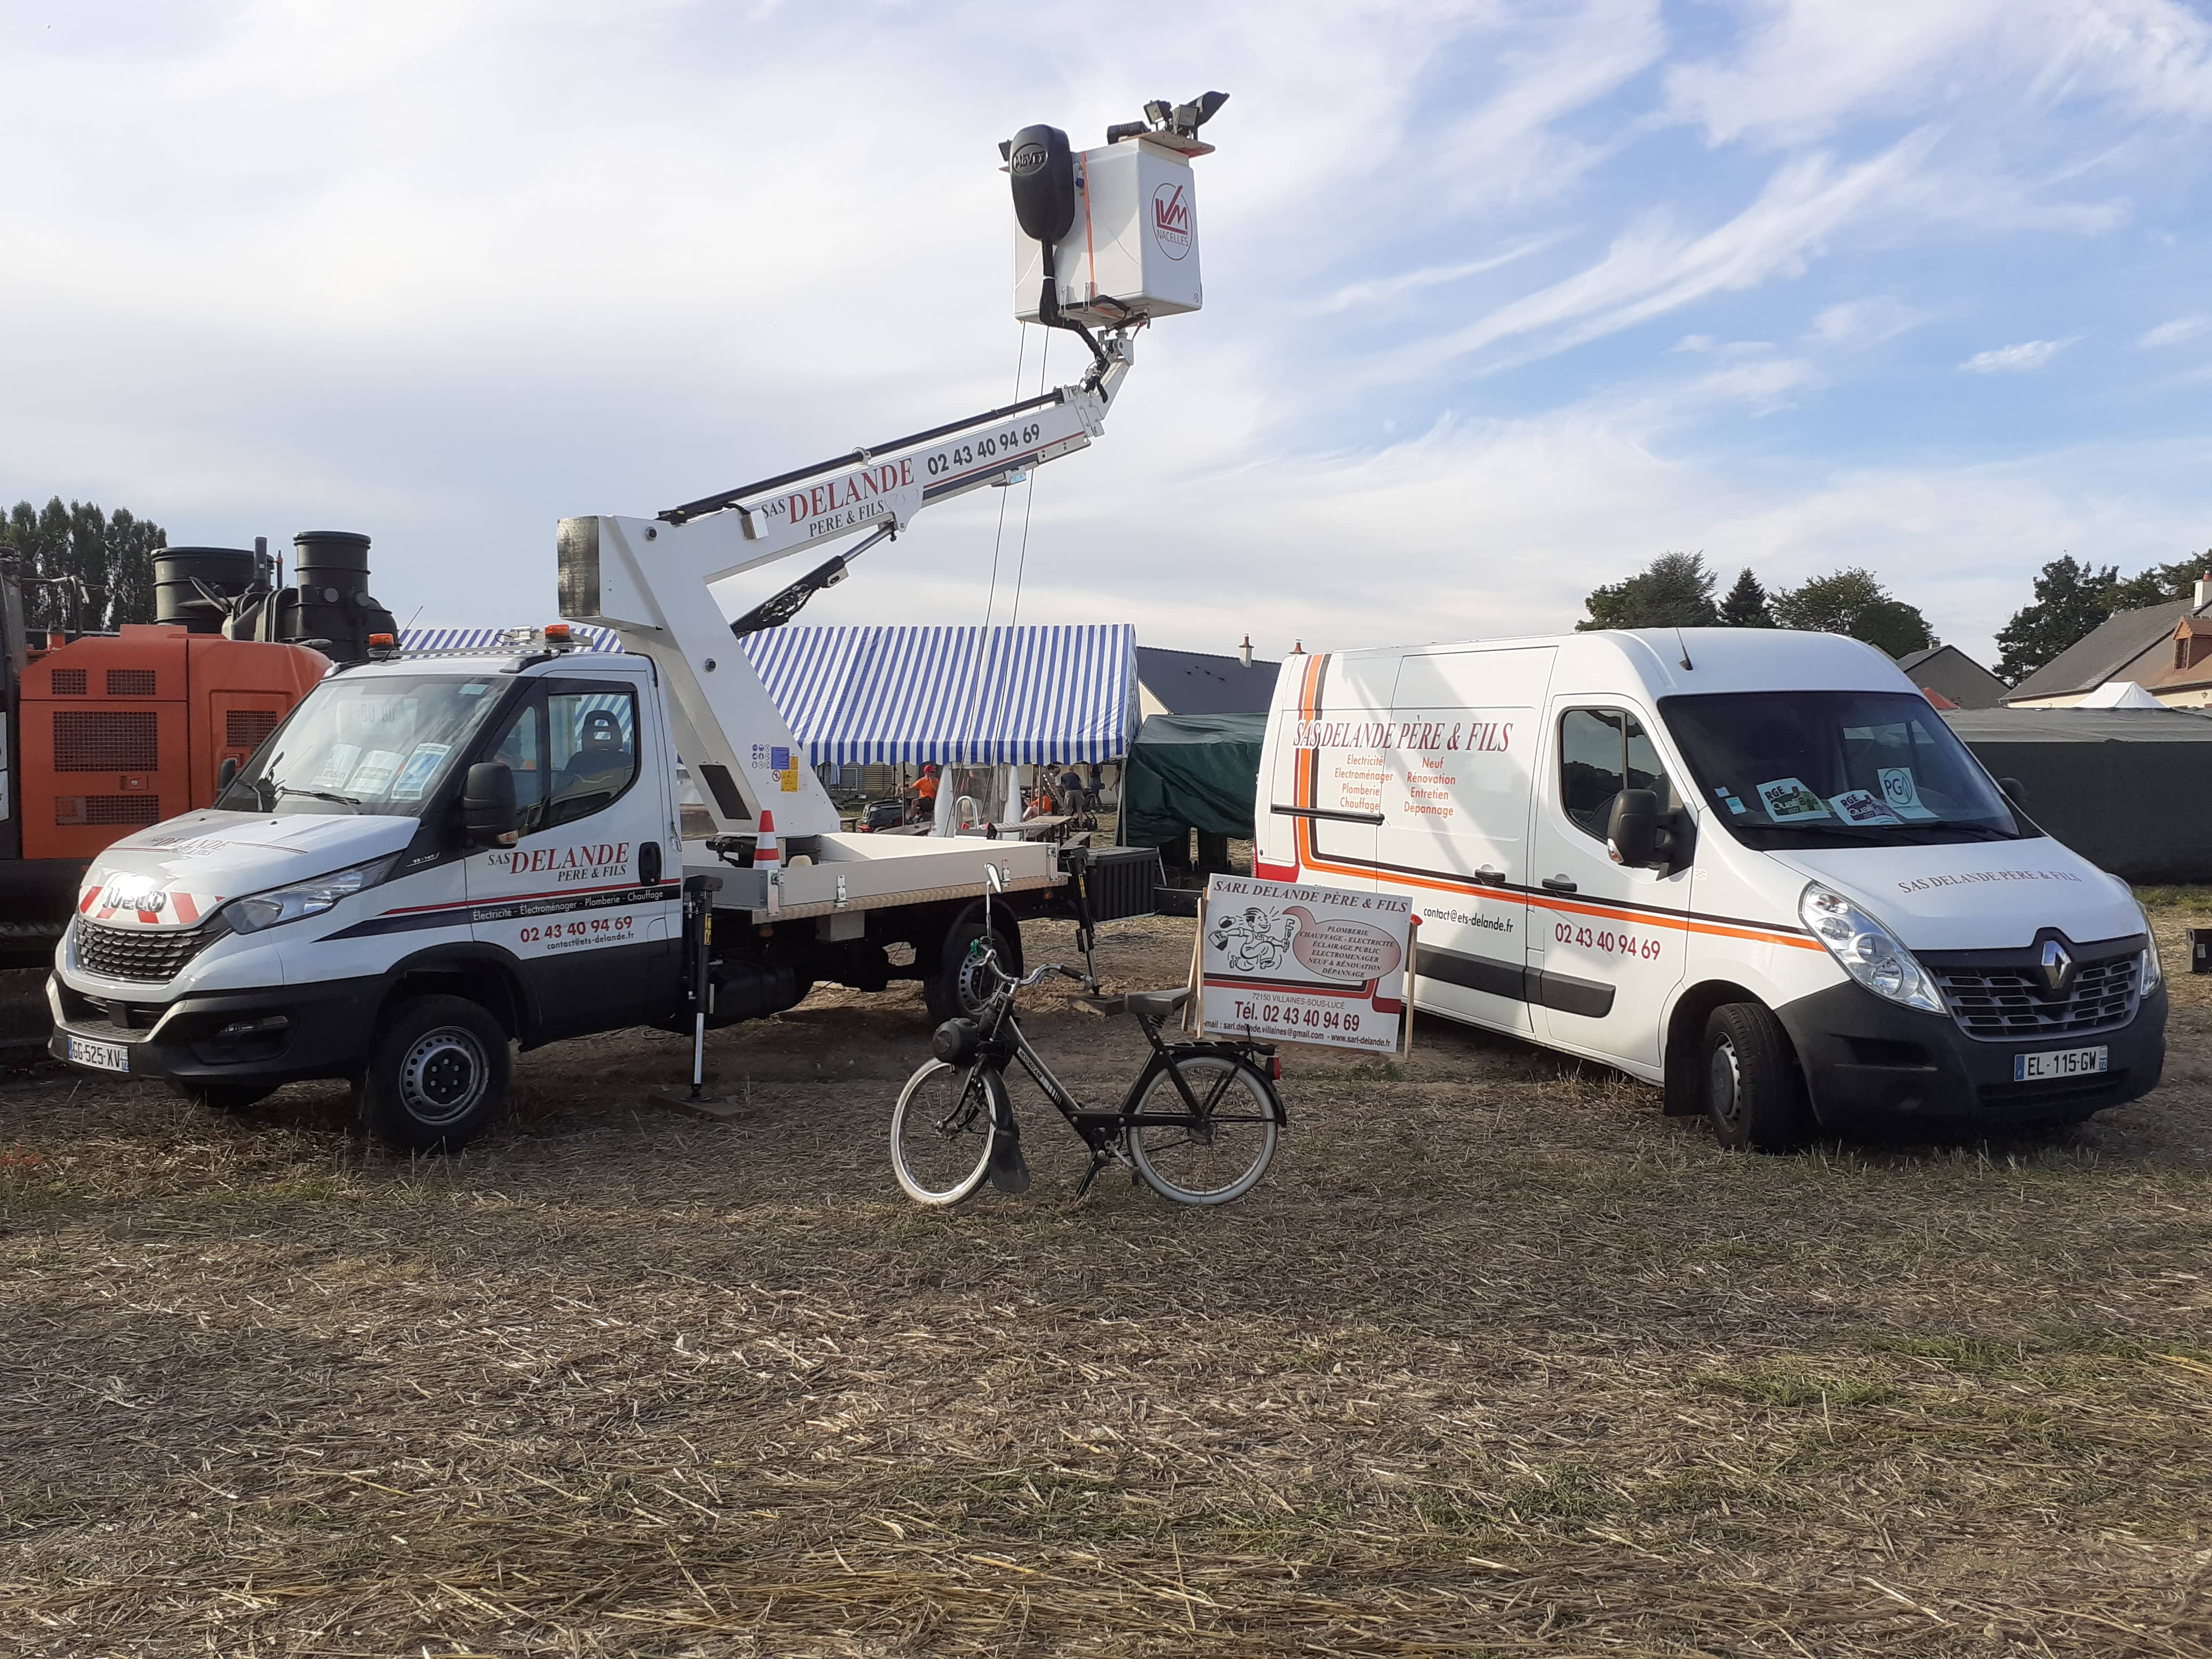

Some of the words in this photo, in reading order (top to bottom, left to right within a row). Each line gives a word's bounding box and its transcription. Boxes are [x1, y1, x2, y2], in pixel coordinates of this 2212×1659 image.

[1157, 229, 1189, 246] NACELLES
[927, 453, 950, 475] 02
[952, 446, 974, 467] 43
[976, 440, 997, 458] 40
[999, 431, 1019, 451] 94
[1022, 423, 1041, 444] 69
[761, 499, 786, 519] SAS
[787, 458, 915, 524] DELANDE
[809, 513, 844, 537] PERE
[846, 509, 856, 525] &
[858, 499, 885, 521] FILS
[1293, 721, 1321, 747] SAS
[1320, 722, 1396, 749] DELANDE
[1395, 714, 1445, 750] PÈRE
[1447, 722, 1462, 750] &
[1464, 722, 1514, 751] FILS
[1347, 754, 1384, 766] Electricité
[1422, 757, 1445, 769] Neuf
[1334, 768, 1393, 783] Electroménager
[1407, 772, 1456, 785] Rénovation
[1342, 782, 1380, 796] Plomberie
[1410, 787, 1449, 800] Entretien
[1764, 786, 1785, 801] RGE
[1340, 797, 1380, 812] Chauffage
[1404, 801, 1454, 818] Dépannage
[1840, 795, 1859, 808] RGE
[488, 853, 510, 866] SAS
[509, 842, 630, 875] DELANDE
[557, 868, 588, 882] PERE
[591, 868, 599, 878] &
[603, 865, 626, 877] FILS
[1898, 879, 1930, 893] SAS
[1927, 872, 2000, 887] DELANDE
[1997, 869, 2038, 880] PÈRE
[2037, 870, 2050, 879] &
[2050, 871, 2082, 882] FILS
[1214, 880, 1250, 895] SARL
[1252, 885, 1320, 902] DELANDE
[1322, 891, 1359, 907] PÈRE
[1362, 898, 1372, 908] &
[1377, 900, 1408, 913] FILS
[473, 909, 512, 921] Électricité
[520, 901, 577, 915] Électroménager
[585, 895, 620, 907] Plomberie
[627, 890, 663, 902] Chauffage
[1423, 907, 1514, 933] contact@ets-delande.fr
[520, 928, 539, 943] 02
[544, 924, 562, 939] 43
[567, 921, 586, 936] 40
[591, 918, 610, 933] 94
[615, 915, 633, 930] 69
[1300, 931, 1342, 941] CHAUFFAGE
[1327, 926, 1369, 936] PLOMBERIE
[547, 931, 634, 950] contact@ets-delande.fr
[1312, 940, 1353, 951] ÉCLAIRAGE
[1354, 946, 1381, 954] PUBLIC
[1555, 923, 1572, 944] 02
[1575, 928, 1594, 948] 43
[1596, 932, 1615, 952] 40
[1618, 936, 1637, 956] 94
[1641, 939, 1661, 961] 69
[1307, 957, 1328, 966] NEUF
[1336, 960, 1381, 971] RÉNOVATION
[1322, 967, 1366, 978] DÉPANNAGE
[1253, 993, 1271, 1001] 72150
[1273, 995, 1345, 1009] VILLAINES-SOUS-LUCÉ
[1235, 1001, 1258, 1020] Tél.
[1263, 1005, 1279, 1022] 02
[1283, 1007, 1299, 1025] 43
[1303, 1010, 1319, 1027] 40
[1324, 1011, 1339, 1029] 94
[1343, 1013, 1359, 1032] 69
[1203, 1020, 1218, 1028] -mail
[1331, 1034, 1391, 1047] www.sarl-delande.fr
[73, 1041, 119, 1067] GG-525-XV
